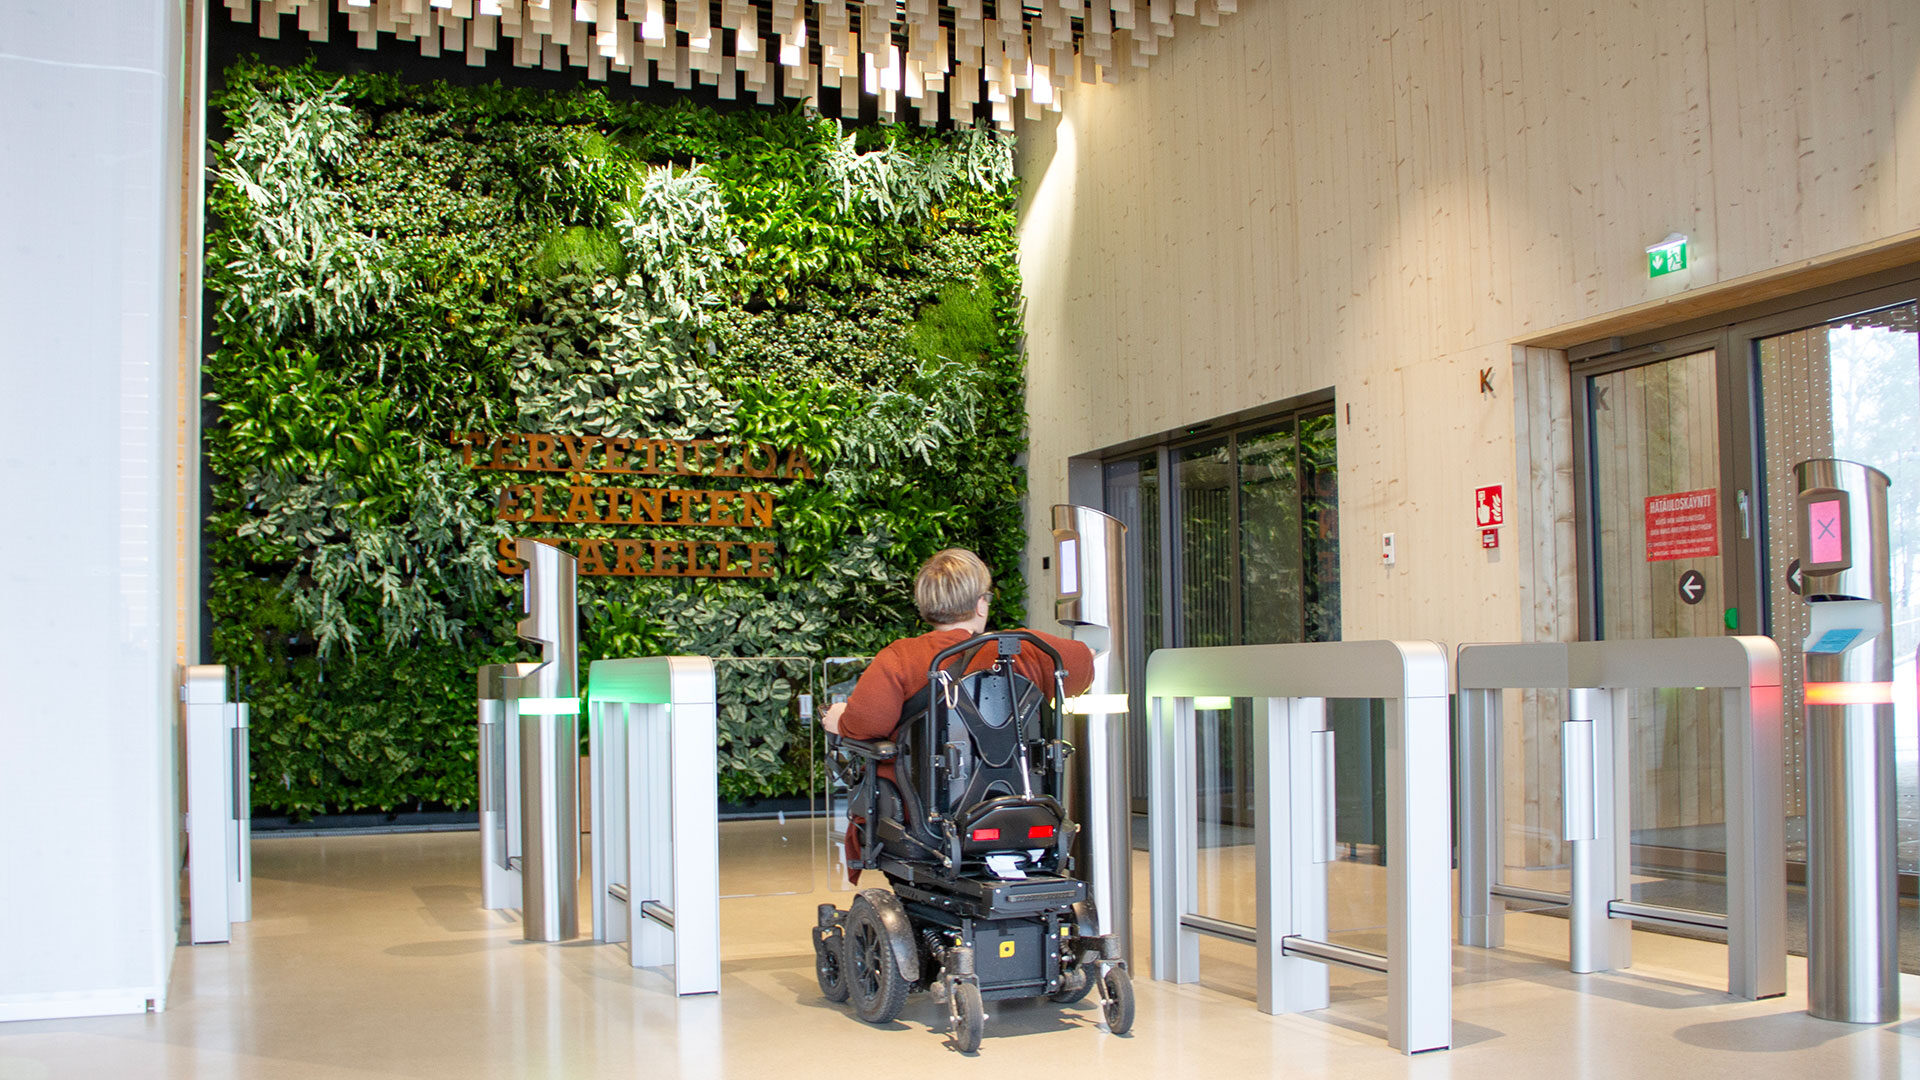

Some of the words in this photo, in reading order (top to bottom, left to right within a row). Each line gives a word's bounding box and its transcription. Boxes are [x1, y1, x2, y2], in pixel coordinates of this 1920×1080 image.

[1480, 367, 1493, 393] K
[450, 430, 815, 479] TERVETULOA
[499, 474, 775, 527] ELÄINTEN
[498, 538, 775, 577] SARELLE
